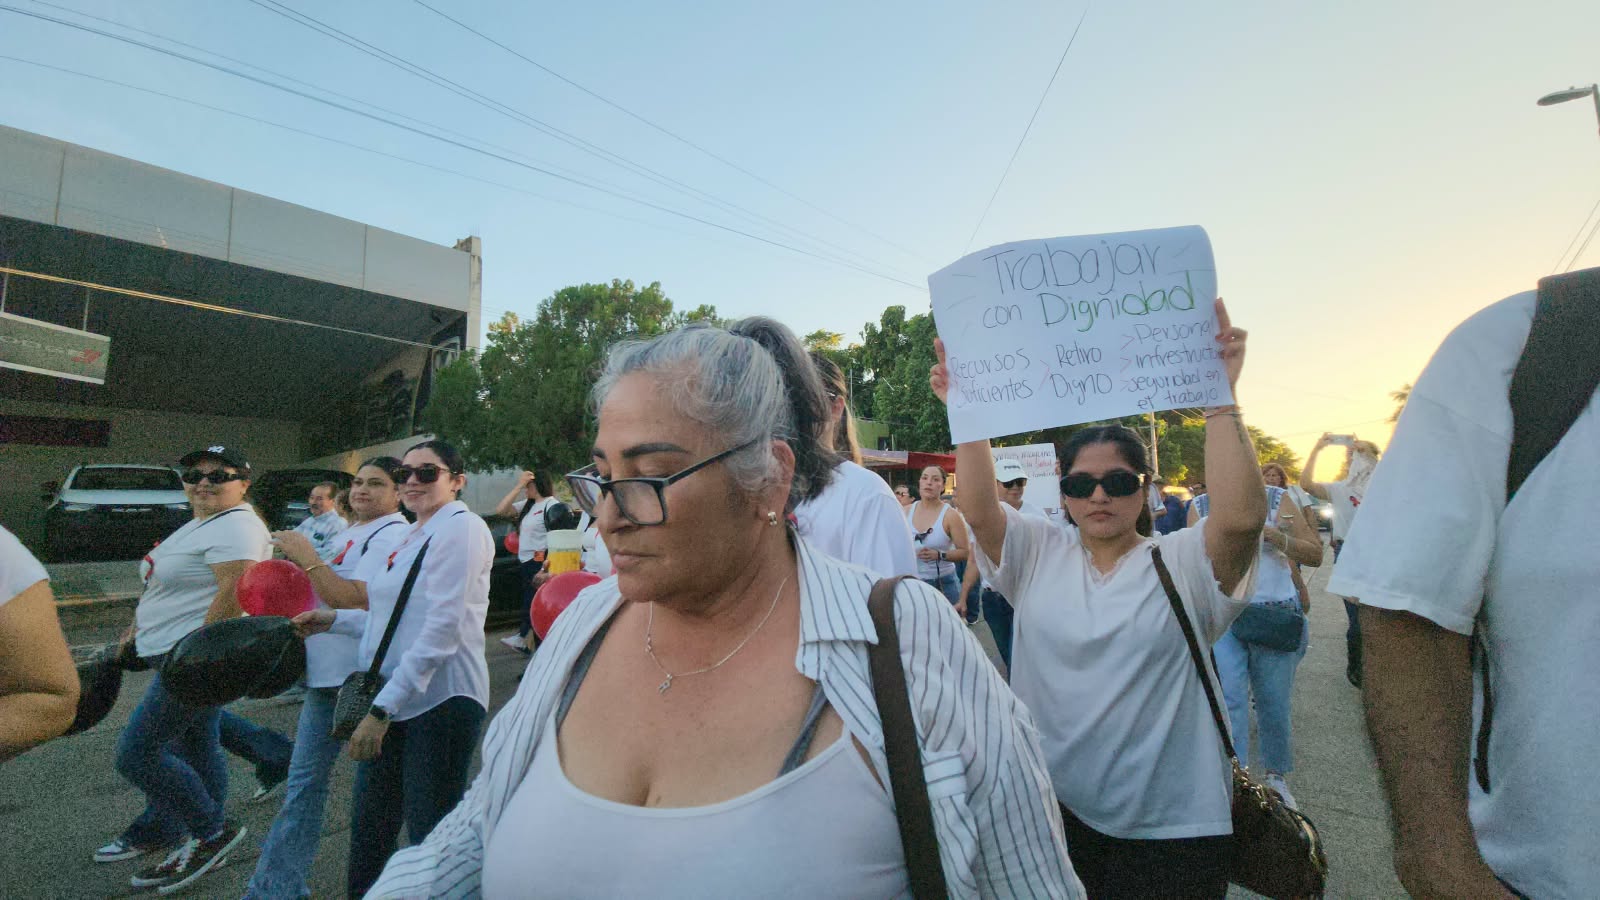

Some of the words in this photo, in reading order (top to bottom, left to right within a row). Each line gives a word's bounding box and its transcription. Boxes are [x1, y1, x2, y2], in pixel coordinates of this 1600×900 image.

[983, 240, 1160, 295] Trabajar
[982, 303, 1022, 329] con
[1036, 269, 1195, 332] Dignidad
[1056, 341, 1102, 368] Retiro
[1050, 372, 1113, 406] Digno
